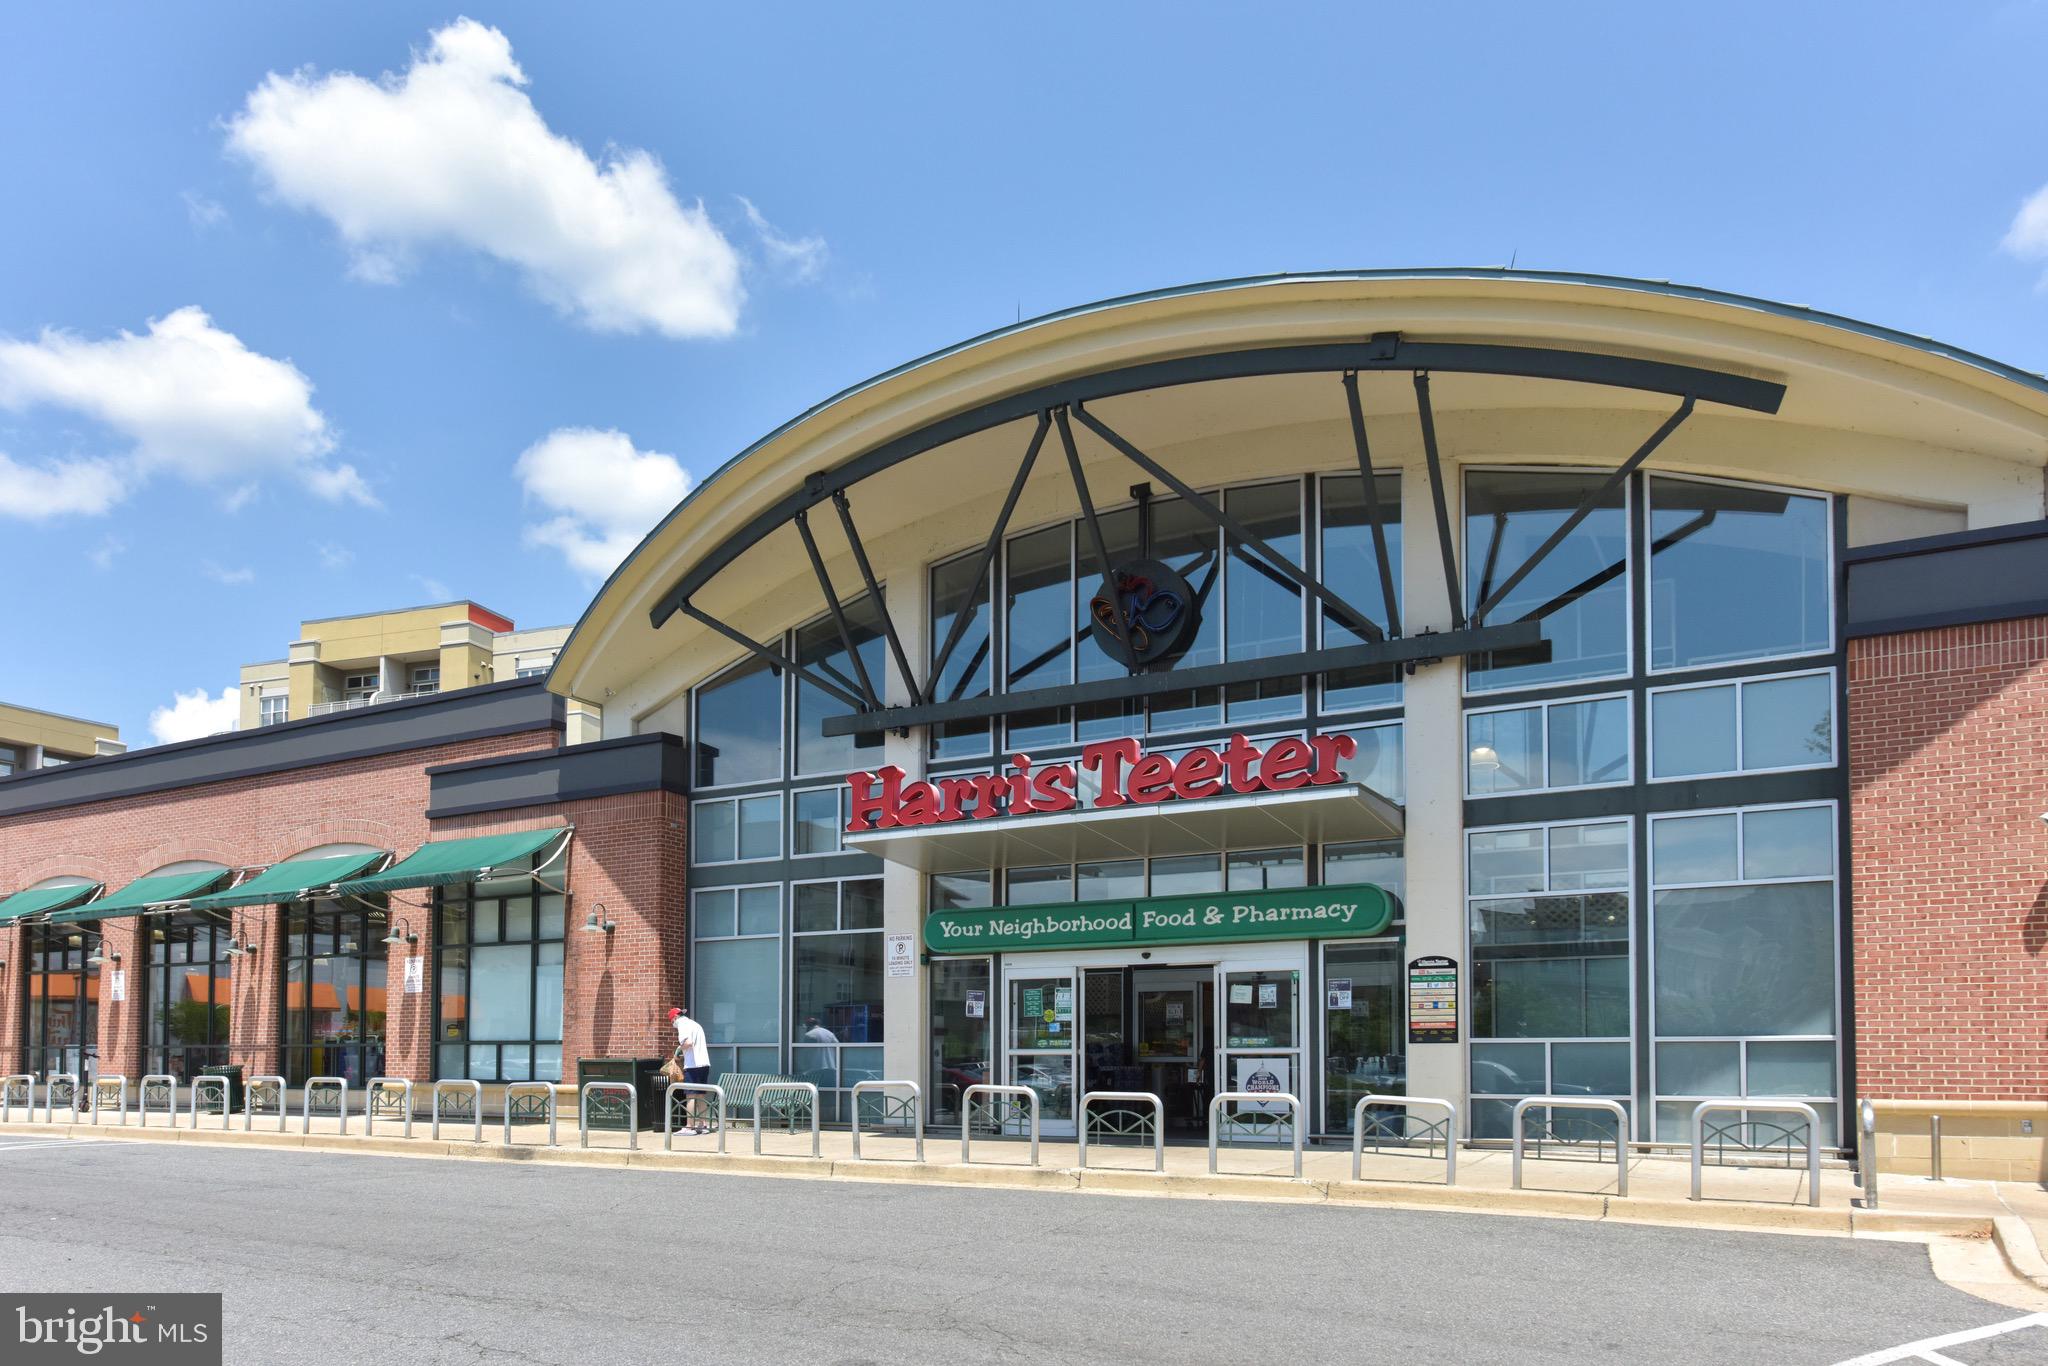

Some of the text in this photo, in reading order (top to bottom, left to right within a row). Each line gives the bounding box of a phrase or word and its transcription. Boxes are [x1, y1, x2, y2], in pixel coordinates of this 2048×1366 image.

[846, 733, 1358, 832] Harris Teeter
[940, 903, 1358, 939] Your Neighborhood Food & Pharmacy
